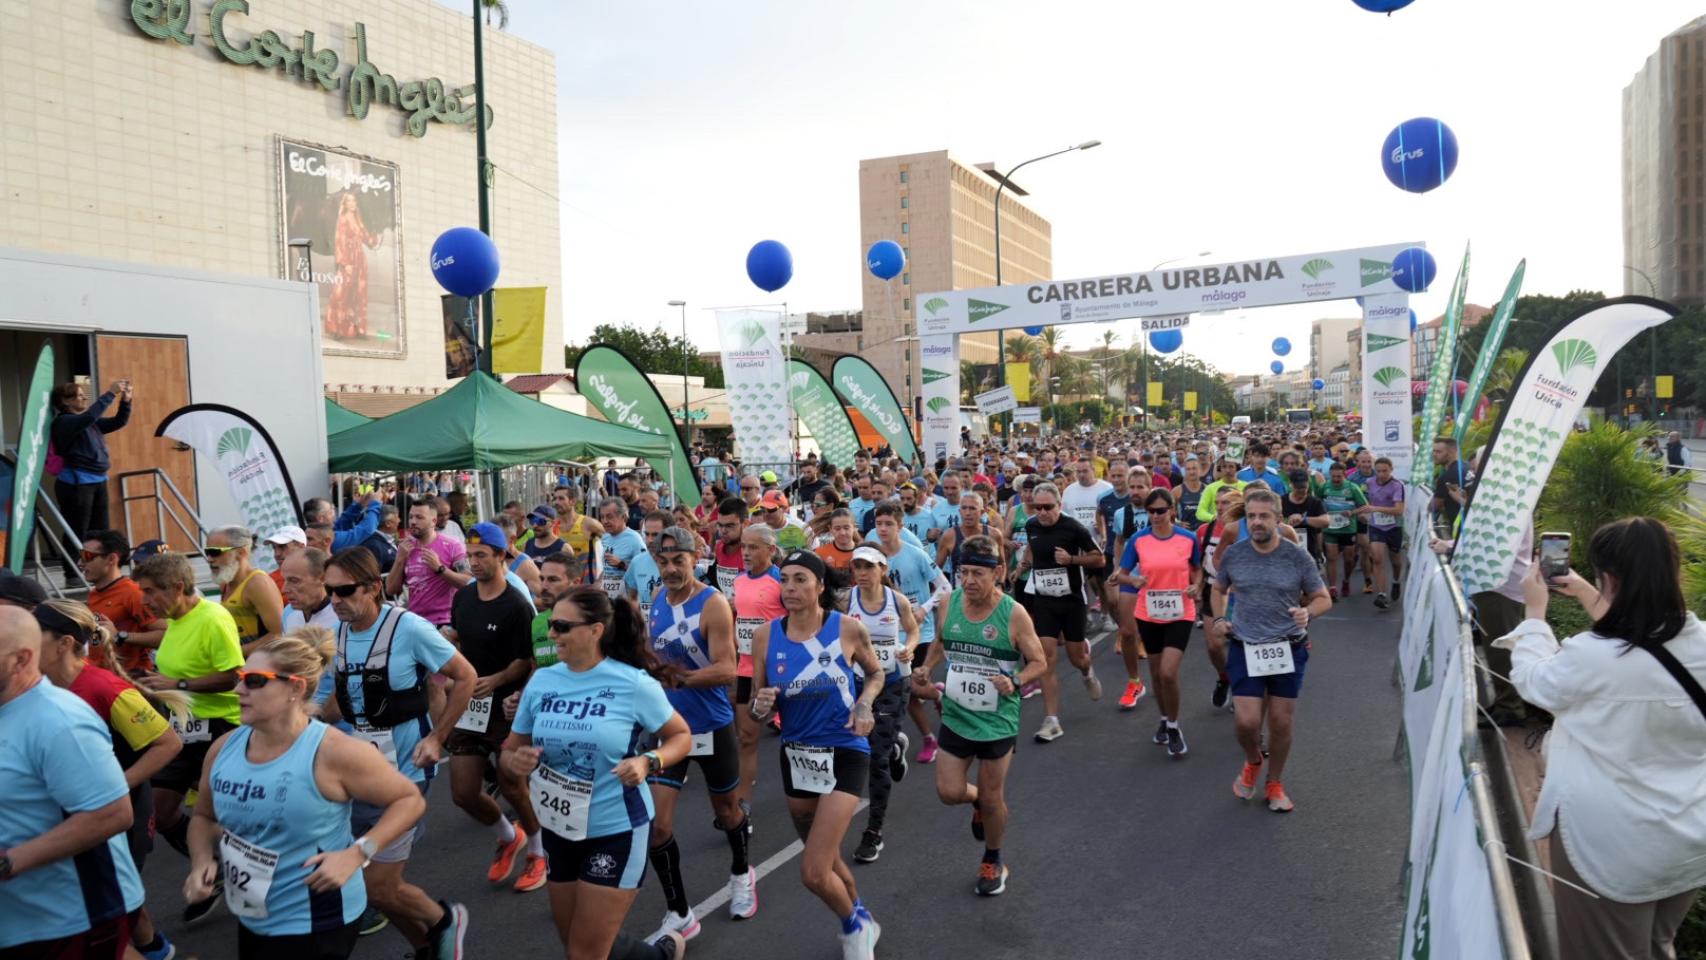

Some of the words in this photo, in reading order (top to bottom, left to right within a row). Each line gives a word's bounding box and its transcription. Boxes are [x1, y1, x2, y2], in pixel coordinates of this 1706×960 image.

[210, 0, 341, 91] Corte
[350, 21, 494, 138] Inglés
[289, 152, 306, 173] El
[306, 157, 342, 182] Corte
[343, 160, 391, 193] Inglés
[1027, 274, 1153, 304] CARRERA
[1162, 260, 1284, 291] URBANA
[1368, 306, 1408, 317] málaga
[1141, 316, 1189, 330] SALIDA
[1041, 577, 1064, 588] 1842
[1152, 599, 1177, 609] 1841
[950, 641, 992, 657] ATLETISMO
[787, 675, 846, 690] DEPORTIVO
[960, 681, 986, 695] 168
[540, 696, 607, 720] nerja
[541, 719, 593, 732] ATLETISMO
[540, 790, 571, 817] 248
